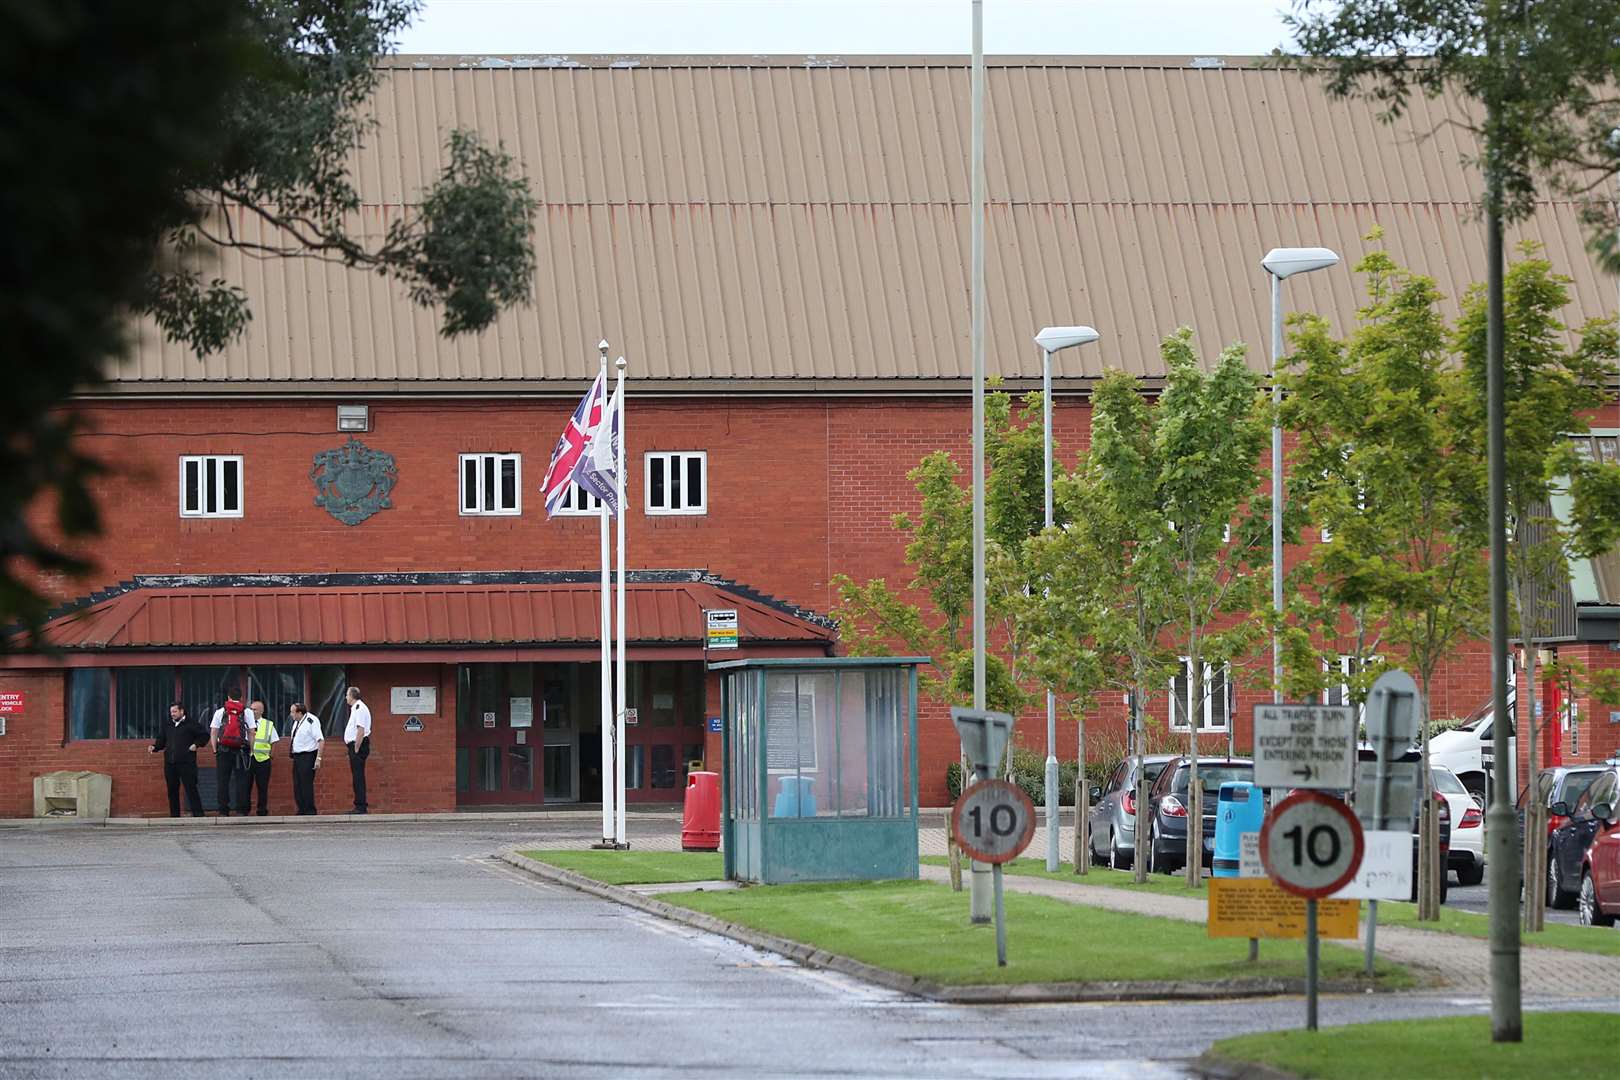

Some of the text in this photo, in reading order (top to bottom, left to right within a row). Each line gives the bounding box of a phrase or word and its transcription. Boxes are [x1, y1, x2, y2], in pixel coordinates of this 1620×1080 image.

[589, 471, 609, 493] Sector
[1263, 709, 1345, 720] ALL TRAFFIC TURN
[1290, 722, 1316, 733] RIGHT
[1260, 735, 1347, 748] EXCEPT FOR THOSE
[1263, 749, 1344, 761] ENTERING PRISON
[968, 804, 1017, 838] 10
[1283, 824, 1342, 868] 10
